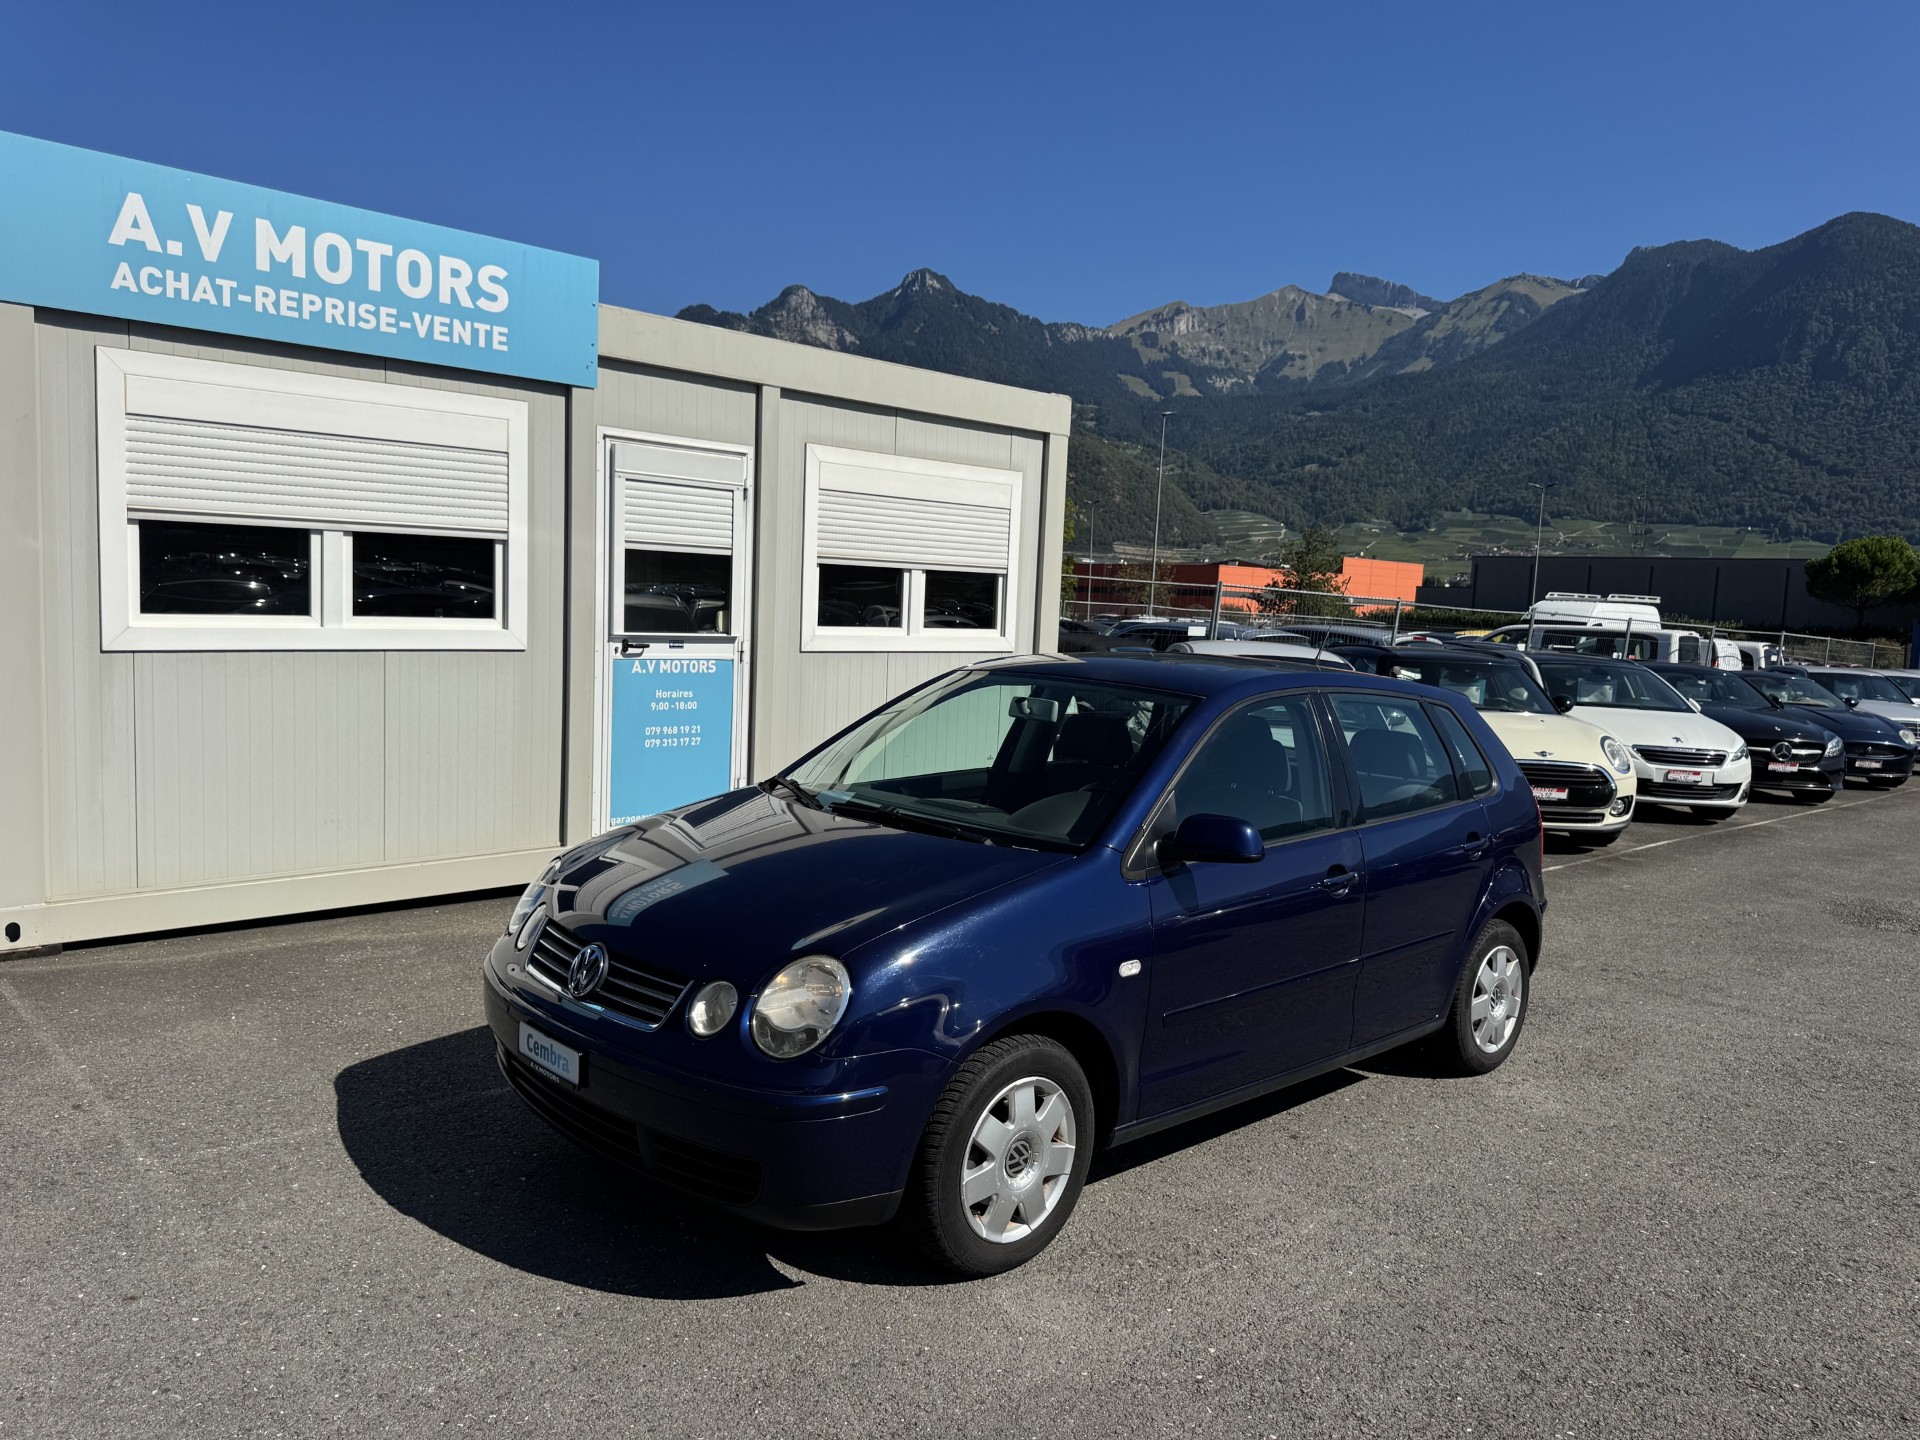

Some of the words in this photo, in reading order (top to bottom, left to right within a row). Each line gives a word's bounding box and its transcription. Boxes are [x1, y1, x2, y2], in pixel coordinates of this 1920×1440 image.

[108, 192, 233, 262] A.V
[255, 218, 509, 312] MOTORS
[110, 261, 509, 352] ACHAT-REPRISE-VENTE
[631, 660, 656, 673] A.V
[660, 660, 717, 673] MOTORS
[656, 689, 694, 698] Horaires
[651, 702, 669, 711] 9:00
[645, 726, 661, 736] 079
[663, 726, 678, 735] 968
[680, 725, 690, 734] 19
[692, 725, 701, 734] 21
[645, 739, 661, 748] 079
[662, 738, 678, 747] 313
[680, 737, 690, 746] 17
[691, 737, 701, 746] 27
[526, 1033, 570, 1074] Cembra
